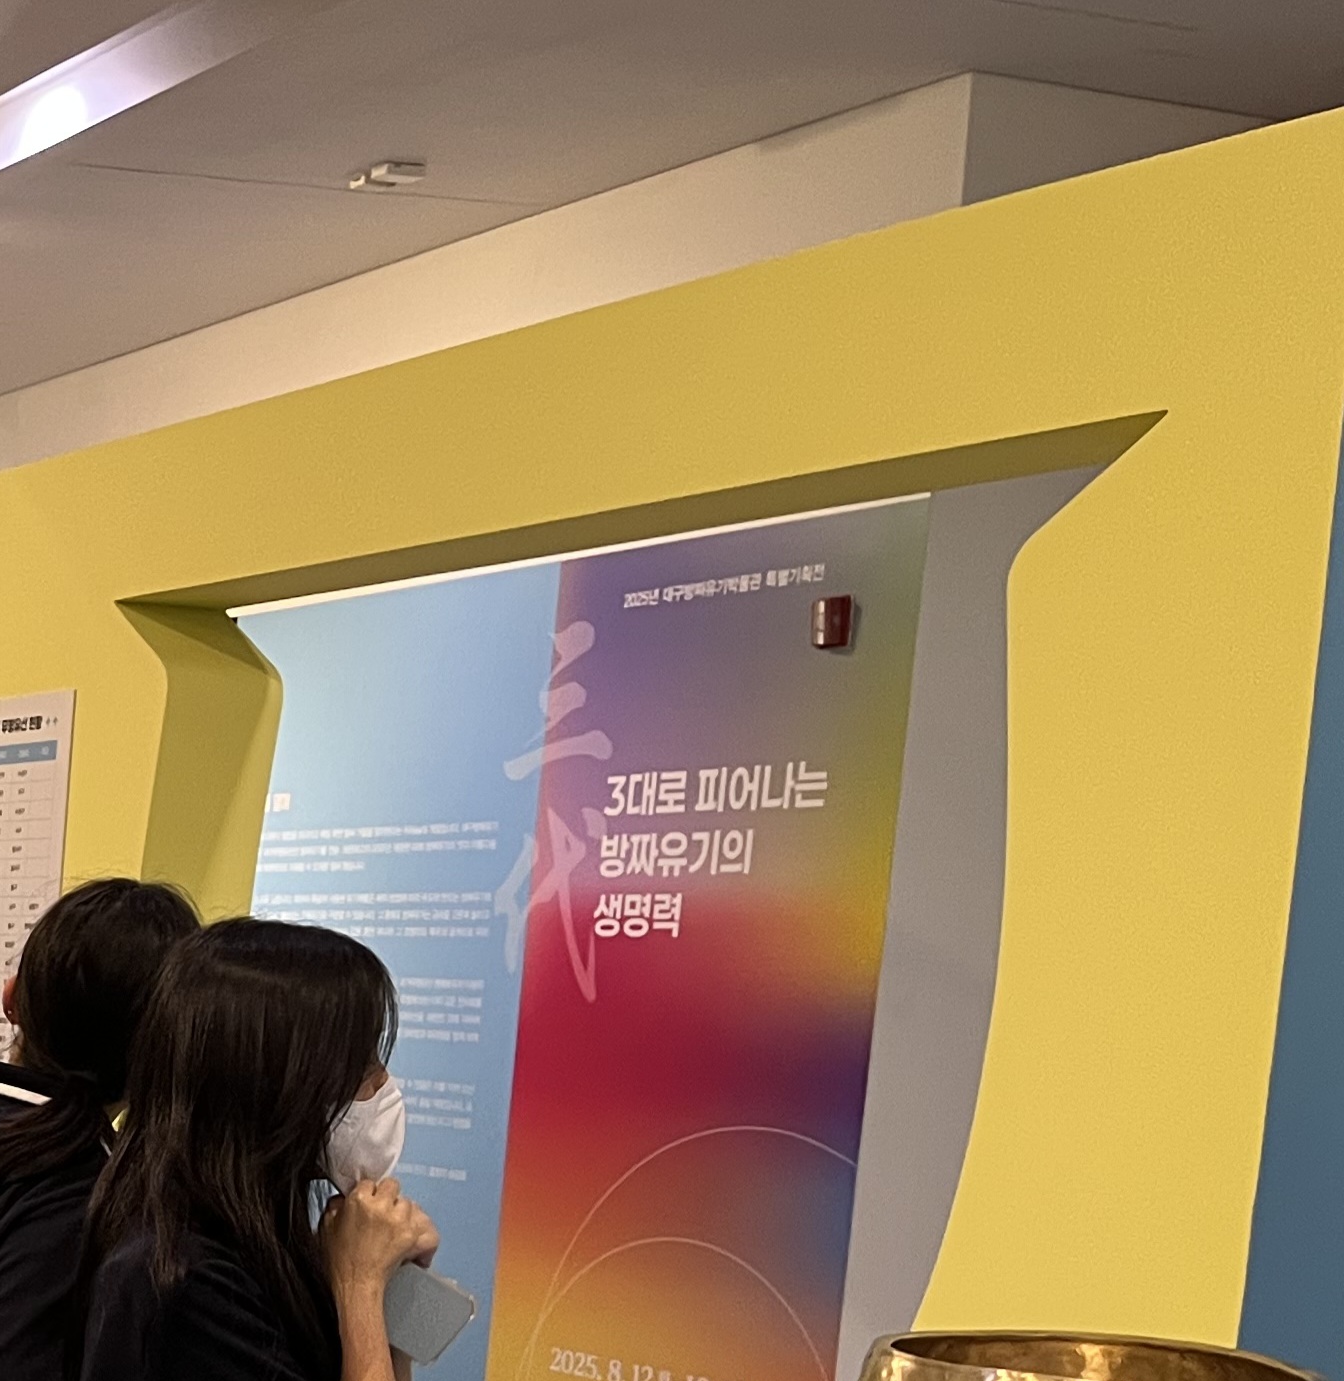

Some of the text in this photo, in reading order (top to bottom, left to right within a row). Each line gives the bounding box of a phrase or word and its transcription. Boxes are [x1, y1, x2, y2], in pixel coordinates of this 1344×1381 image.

[605, 761, 829, 817] 3대로 피어나는
[599, 828, 753, 879] 방짜유기의
[593, 892, 683, 939] 생명력
[549, 1347, 602, 1381] 2025.
